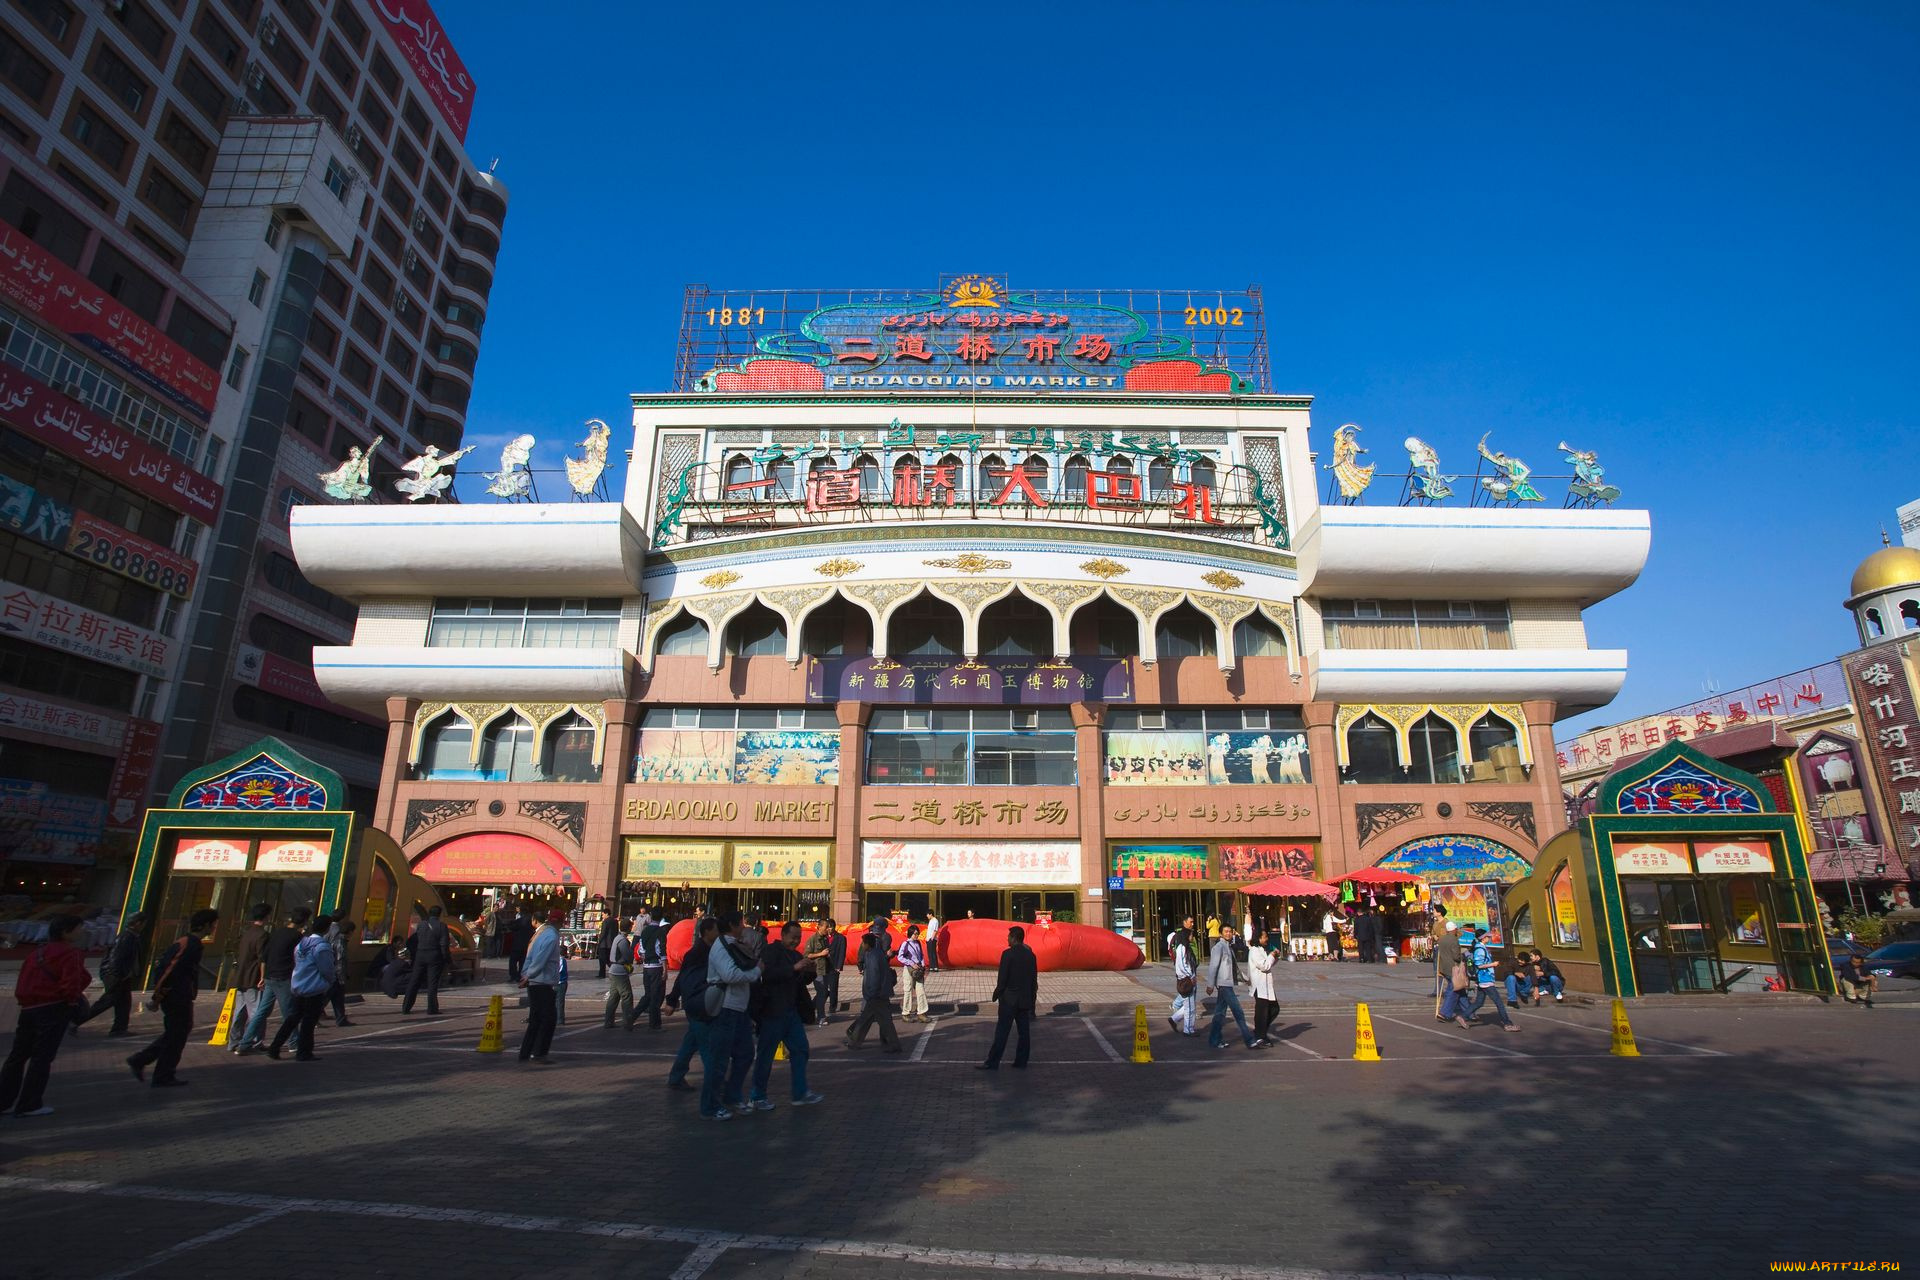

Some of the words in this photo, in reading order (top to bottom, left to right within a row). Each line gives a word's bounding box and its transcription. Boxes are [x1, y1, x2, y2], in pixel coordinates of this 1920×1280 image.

[706, 307, 766, 326] 1881
[1184, 307, 1245, 326] 2002
[837, 332, 1113, 362] 二道桥市场
[833, 375, 993, 387] ERDAOQIAO
[1004, 375, 1116, 387] MARKET
[723, 462, 1226, 525] 二道桥大巴扎
[73, 530, 190, 596] 2888888
[3, 590, 168, 665] 合拉斯宾馆
[0, 697, 101, 734] 合拉斯宾馆
[625, 799, 738, 822] ERDAOQIAO
[754, 801, 833, 822] MARKET
[867, 799, 1070, 825] 二道桥市场
